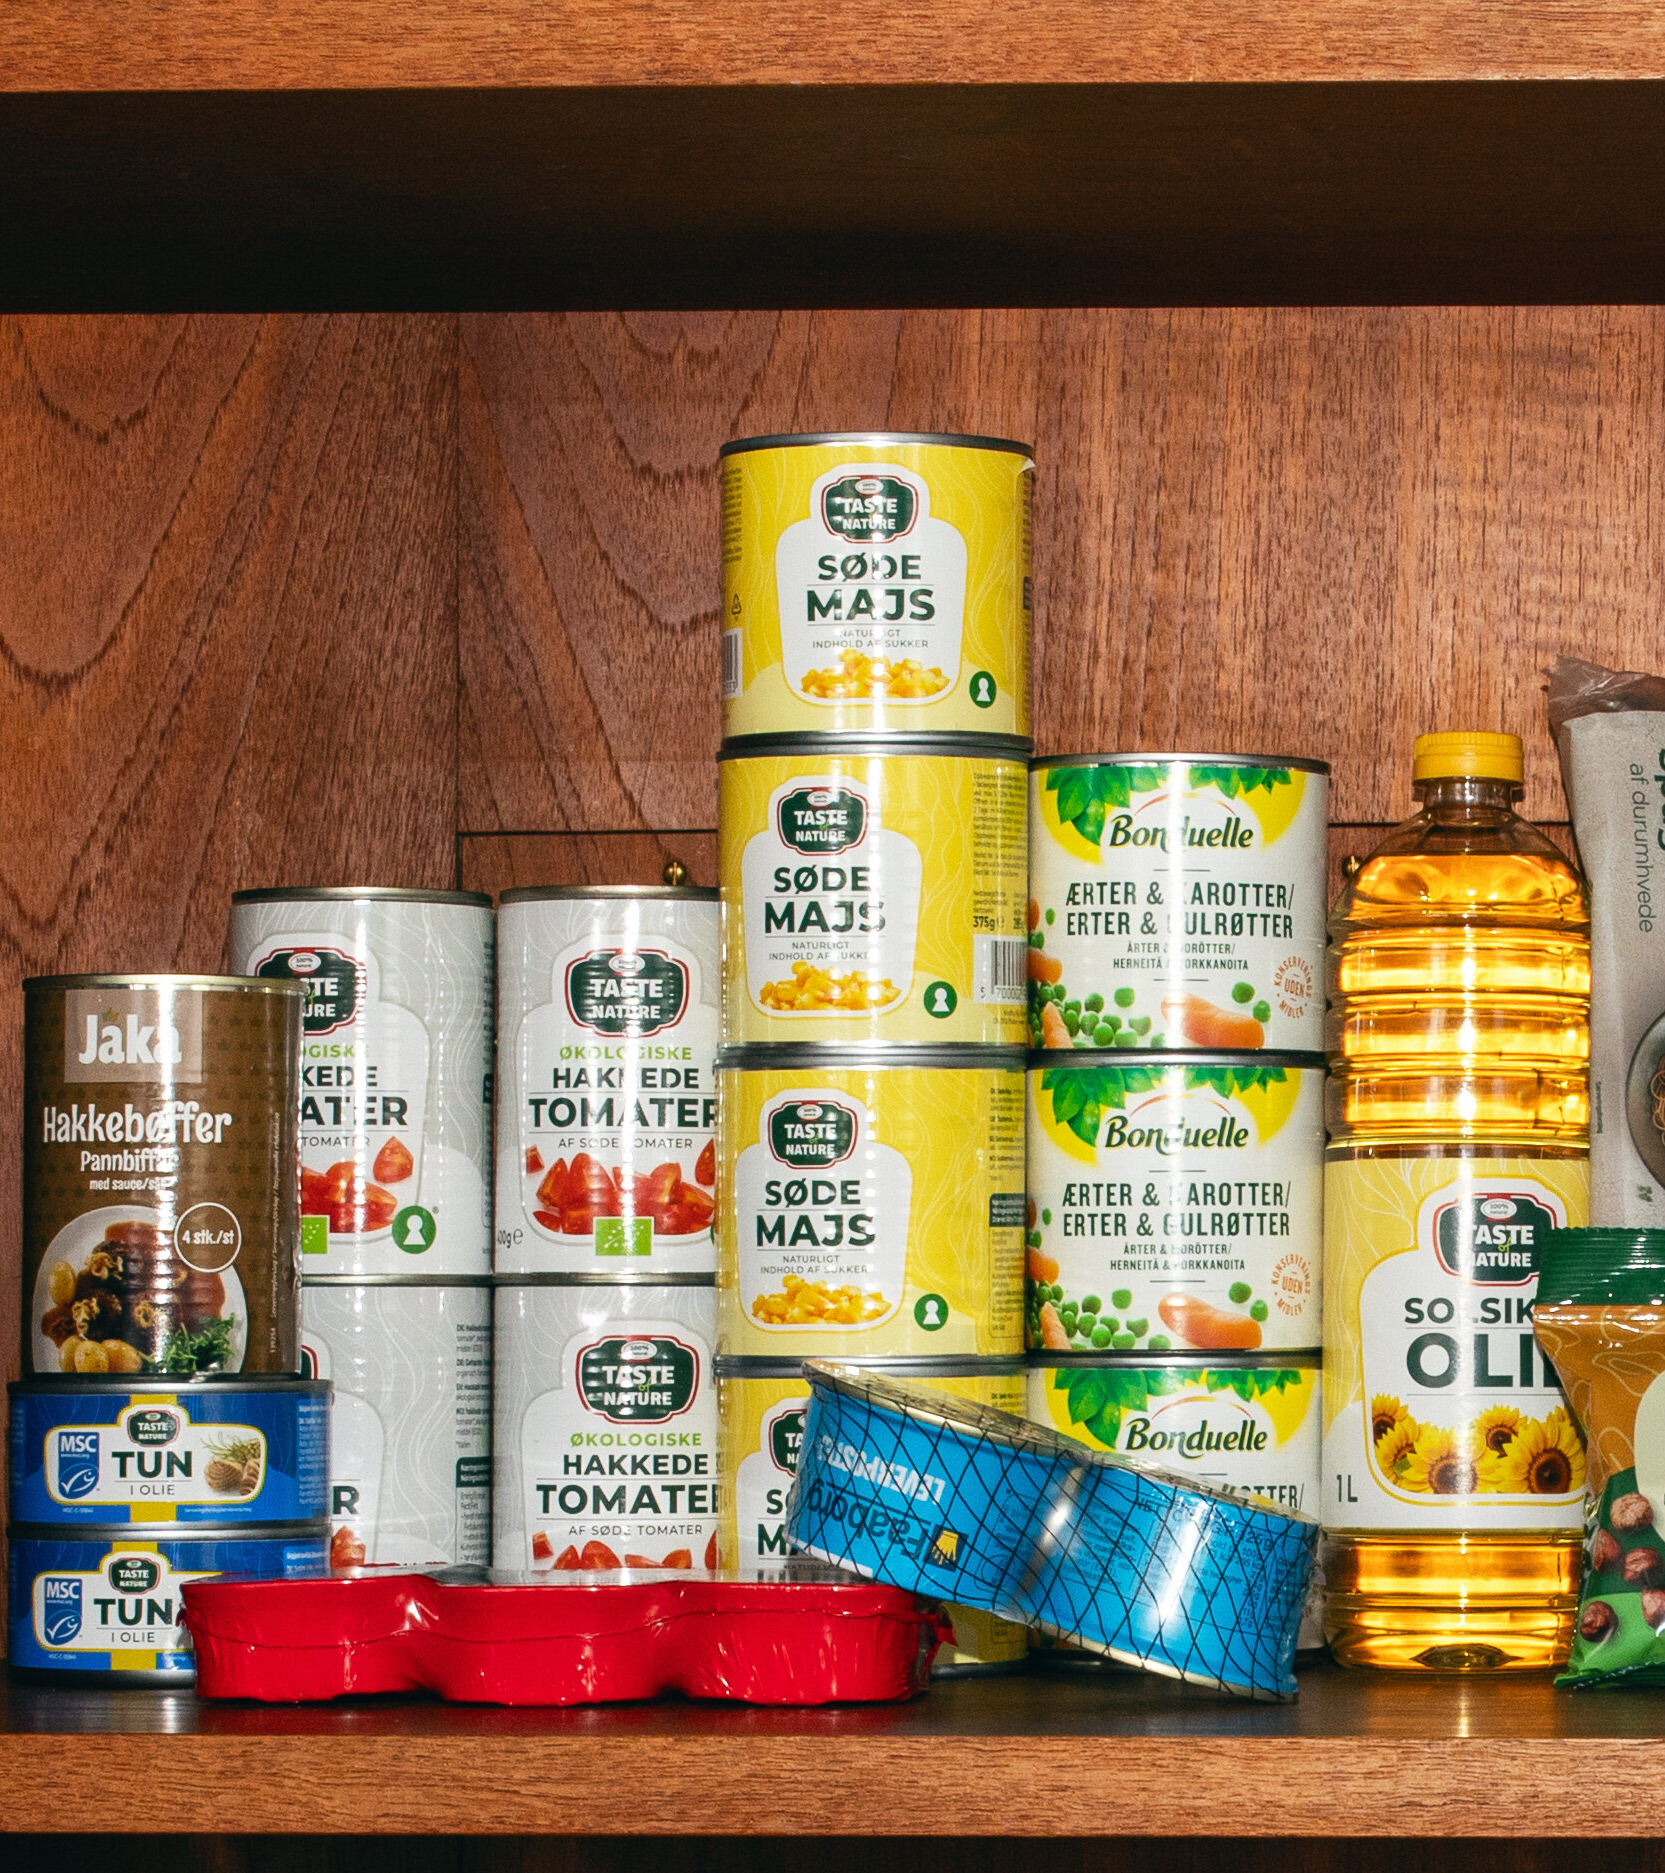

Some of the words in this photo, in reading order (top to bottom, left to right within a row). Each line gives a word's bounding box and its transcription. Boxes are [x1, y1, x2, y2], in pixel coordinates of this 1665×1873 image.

[842, 498, 897, 513] TASTE
[842, 519, 896, 530] NATURE
[817, 552, 921, 582] SØDE
[806, 589, 935, 621] MAJS
[885, 640, 929, 649] SUKKER
[1630, 763, 1648, 786] af
[794, 810, 848, 826] TASTE
[795, 830, 846, 842] NATURE
[1632, 790, 1657, 933] durumhvede
[773, 864, 872, 894] SØDE
[1066, 882, 1136, 906] ÆRTER
[1147, 882, 1164, 904] &
[764, 901, 886, 934] MAJS
[973, 916, 996, 929] 375g
[1067, 912, 1130, 935] ERTER
[1140, 912, 1158, 935] &
[768, 952, 813, 961] INDHOLD
[590, 978, 664, 998] TASTE
[78, 1014, 182, 1065] Jaka
[43, 1099, 232, 1145] Hakkebøffer
[784, 1123, 836, 1140] TASTE
[785, 1144, 835, 1156] NATURE
[90, 1178, 109, 1191] med
[765, 1178, 861, 1207] SØDE
[1062, 1182, 1133, 1207] ÆRTER
[1142, 1182, 1160, 1206] &
[756, 1214, 876, 1247] MAJS
[1063, 1213, 1127, 1236] ERTER
[1136, 1213, 1154, 1236] &
[193, 1230, 235, 1245] stk./st
[1471, 1224, 1534, 1245] TASTE
[782, 1255, 840, 1264] NATURLIGT
[1110, 1257, 1157, 1271] HERNEITÄ
[760, 1265, 803, 1274] INDHOLD
[1282, 1276, 1303, 1295] UDEN
[603, 1365, 675, 1384] TASTE
[603, 1391, 672, 1406] NATURE
[138, 1422, 169, 1432] TASTE
[60, 1434, 97, 1452] MSC
[570, 1431, 702, 1448] ØKOLOGISKE
[1125, 1417, 1268, 1459] Bonduelle
[111, 1451, 192, 1478] TUN
[563, 1454, 709, 1476] HAKKEDE
[140, 1485, 175, 1495] OLIE
[1336, 1474, 1358, 1502] 1L
[637, 1525, 703, 1536] TOMATER
[118, 1569, 149, 1579] TASTE
[46, 1581, 79, 1599] MSC
[94, 1599, 173, 1625] TUN
[121, 1632, 155, 1643] OLIE
